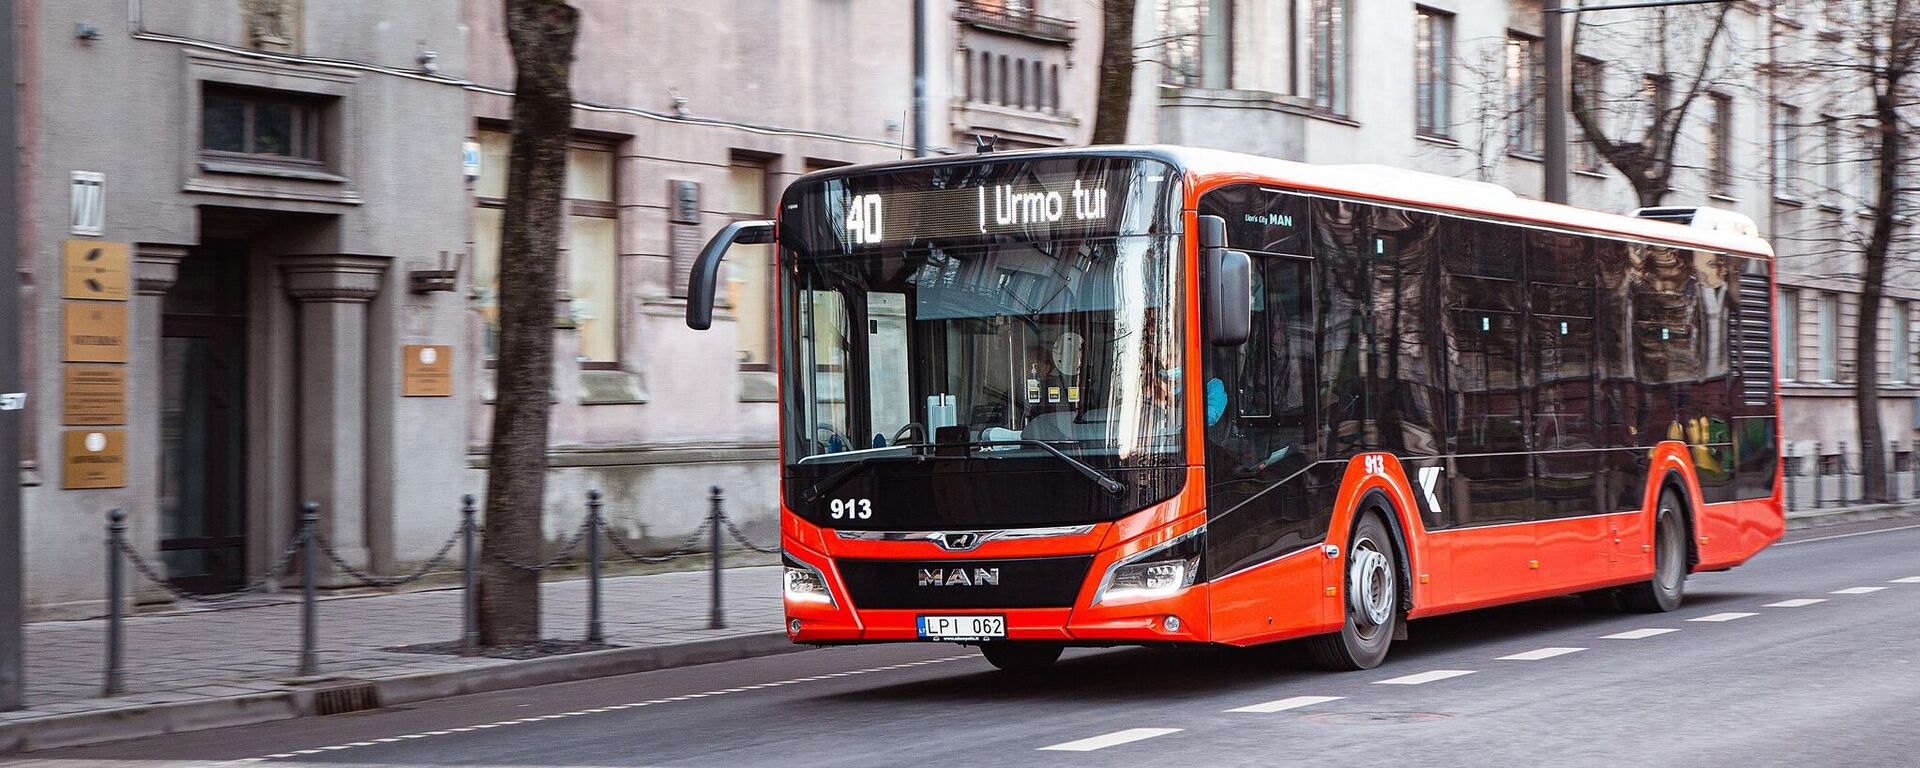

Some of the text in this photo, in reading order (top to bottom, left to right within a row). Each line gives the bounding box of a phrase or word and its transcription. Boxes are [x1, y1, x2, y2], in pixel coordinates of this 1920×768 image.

[996, 184, 1062, 225] Urmo
[846, 194, 882, 244] 40
[1269, 213, 1292, 227] MAN
[1364, 454, 1385, 474] 913
[830, 498, 872, 519] 913
[918, 568, 999, 586] MAN
[927, 618, 1002, 634] LPI 062
